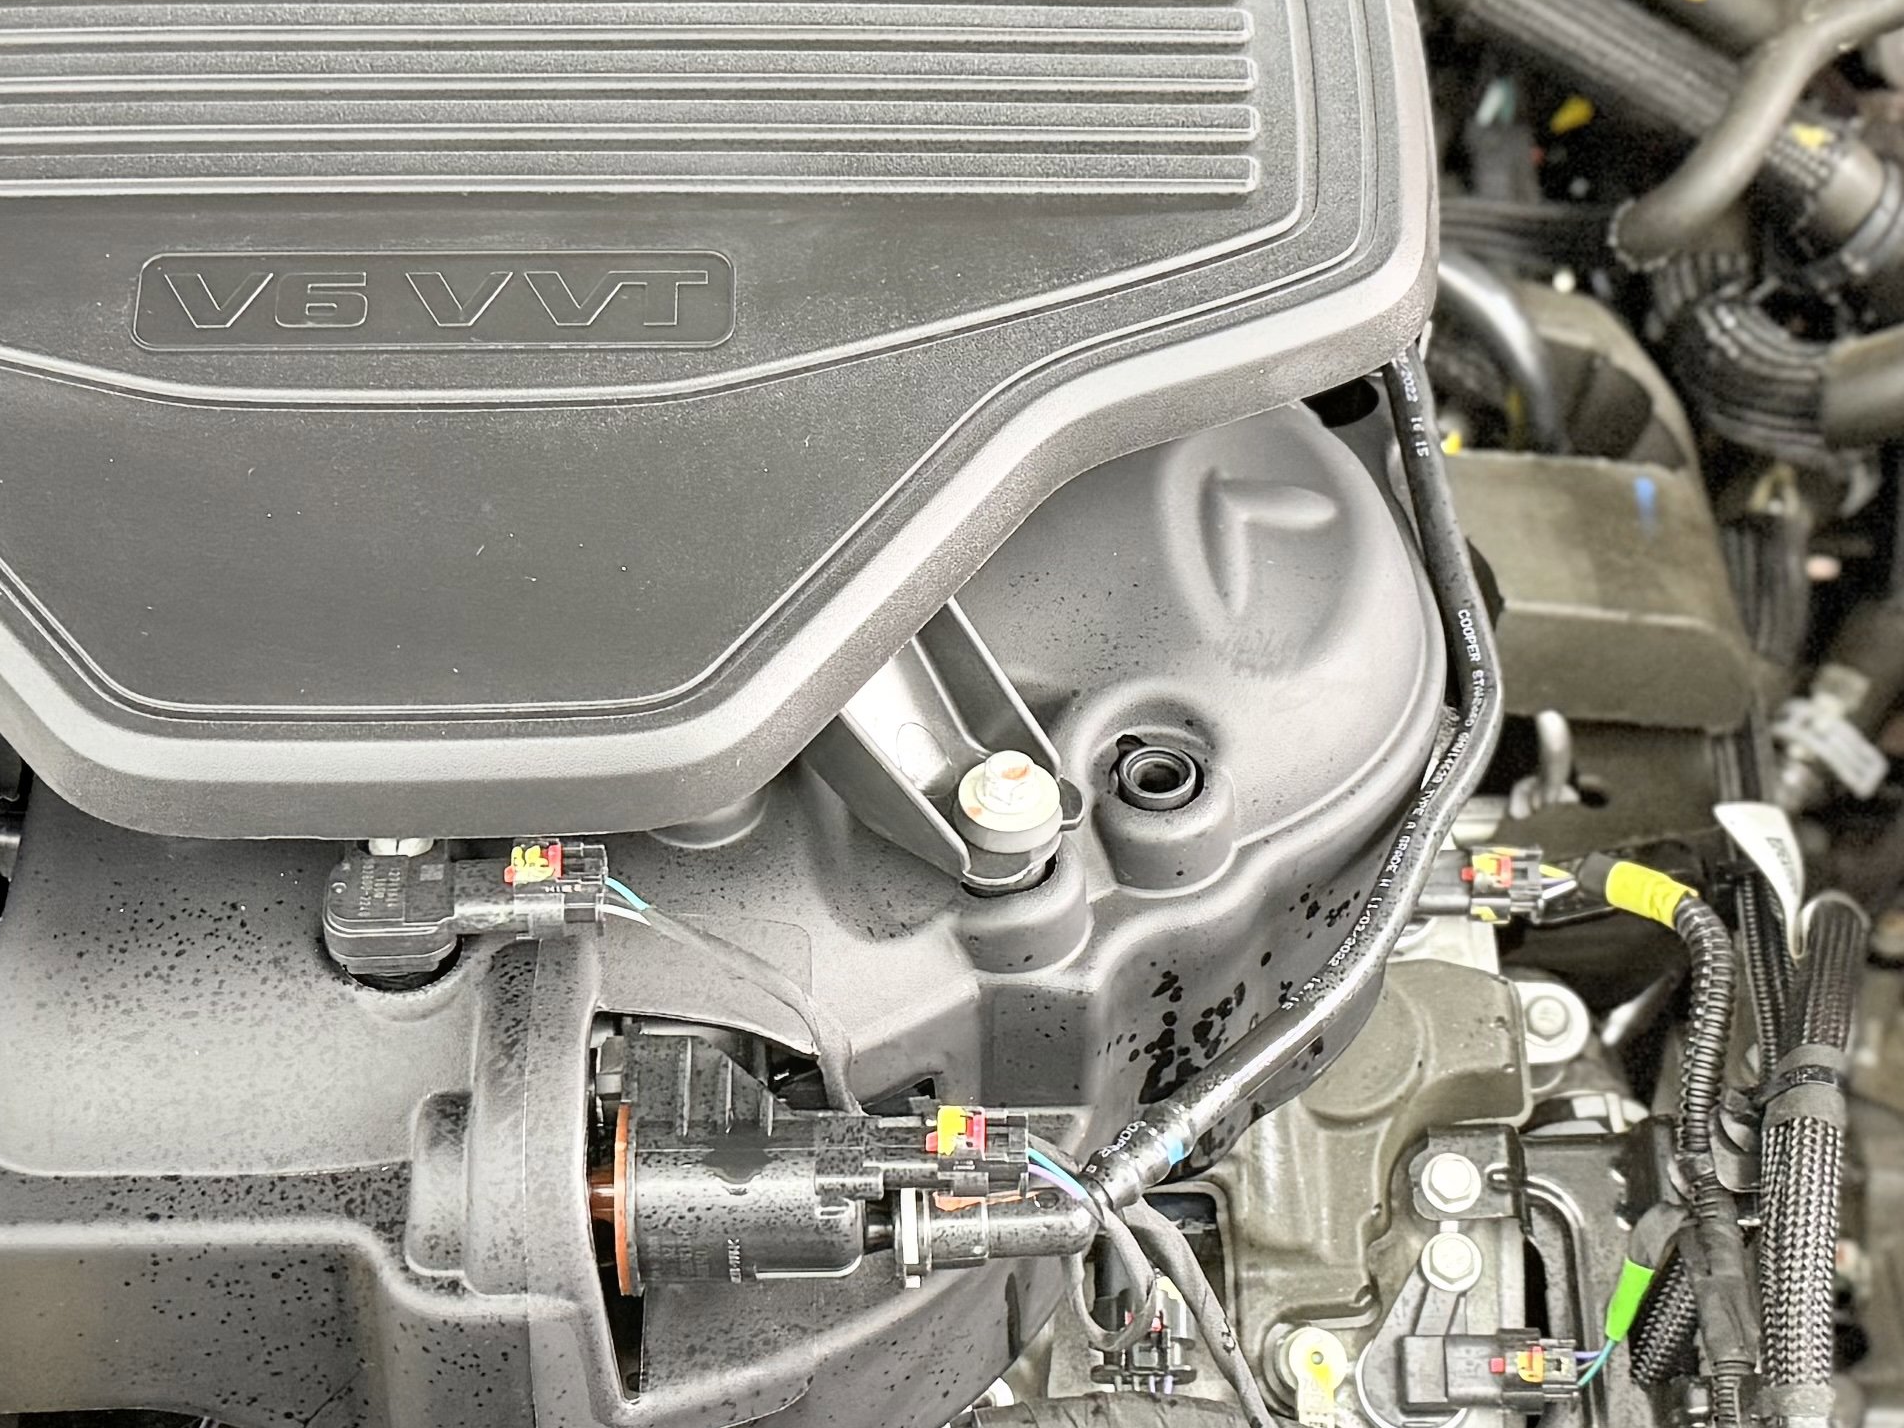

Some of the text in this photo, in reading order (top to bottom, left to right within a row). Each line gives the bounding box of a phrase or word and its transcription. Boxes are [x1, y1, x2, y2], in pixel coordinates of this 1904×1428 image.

[164, 267, 713, 330] V6 VVT
[1457, 608, 1484, 663] COOPER
[1413, 788, 1437, 818] TYPE
